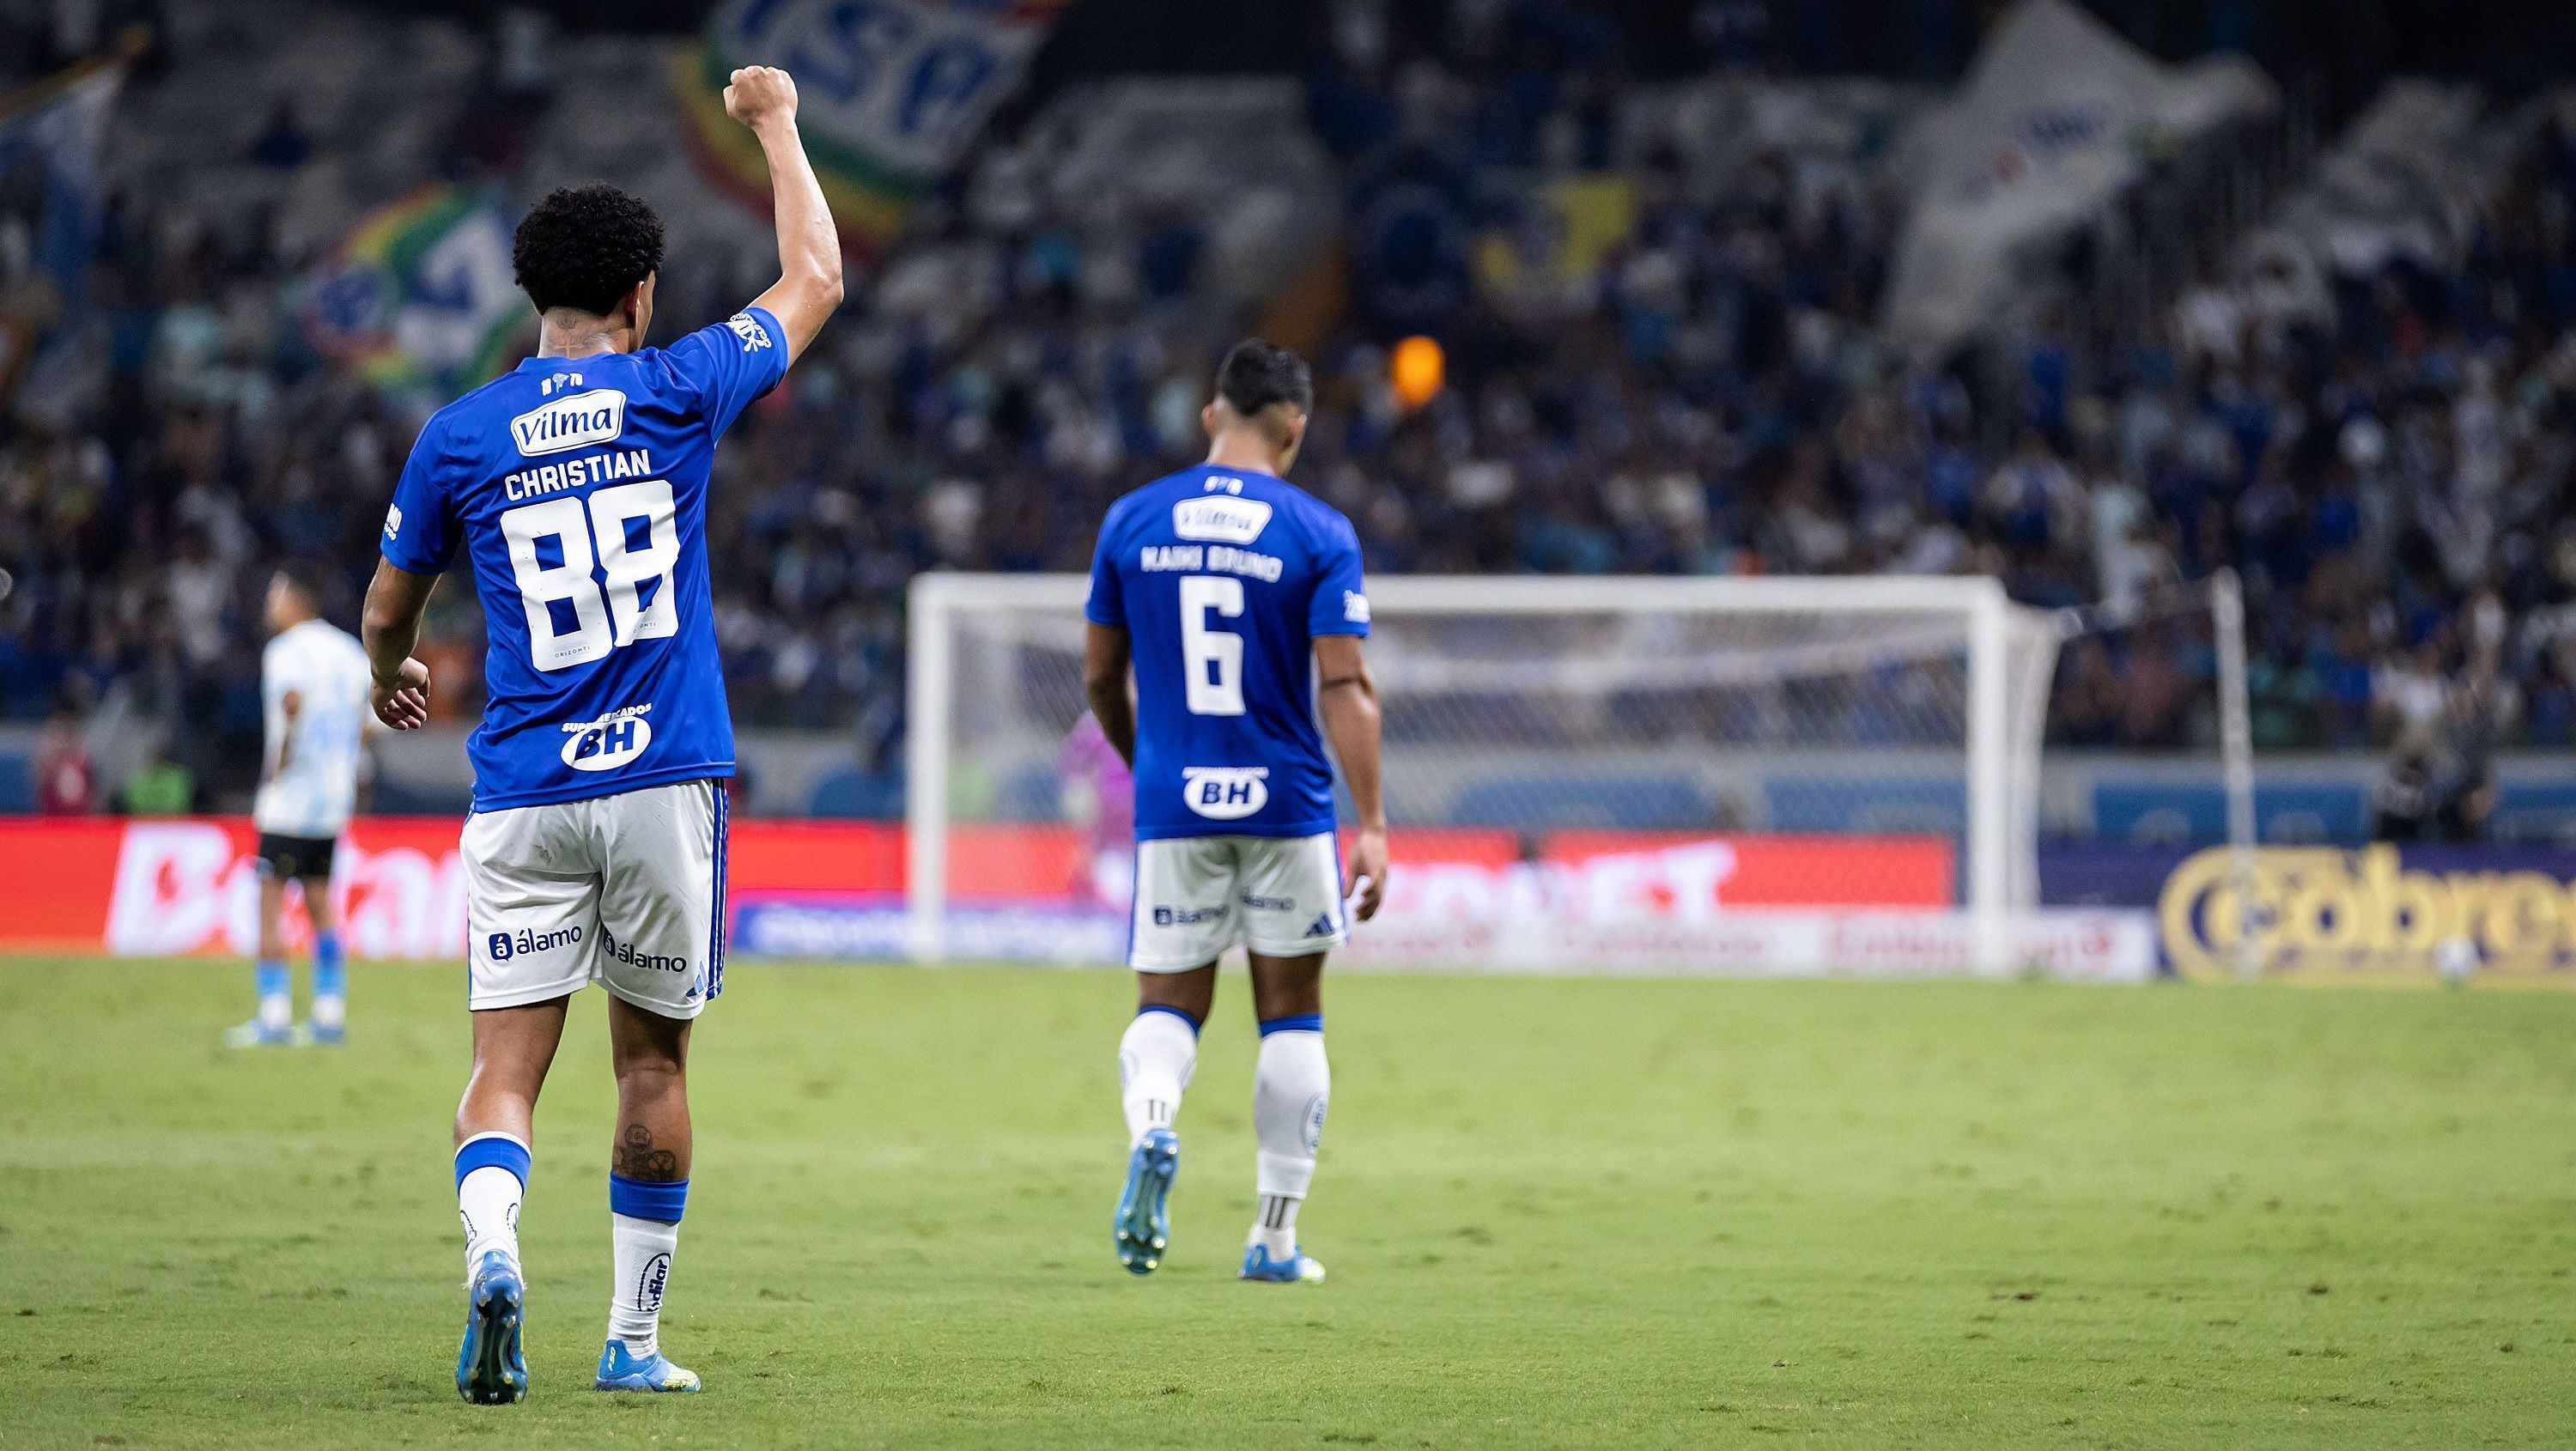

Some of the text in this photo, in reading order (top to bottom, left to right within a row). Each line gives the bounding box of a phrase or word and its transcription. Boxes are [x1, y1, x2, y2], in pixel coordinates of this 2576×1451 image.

[519, 407, 612, 446] Vilma
[504, 449, 652, 501] CHRISTIAN
[500, 479, 681, 672] 88
[555, 646, 591, 659] ORIZONTI
[1179, 575, 1247, 716] 6
[574, 719, 636, 761] BH
[1201, 782, 1250, 804] BH
[516, 926, 582, 954] álamo
[617, 943, 687, 973] álamo
